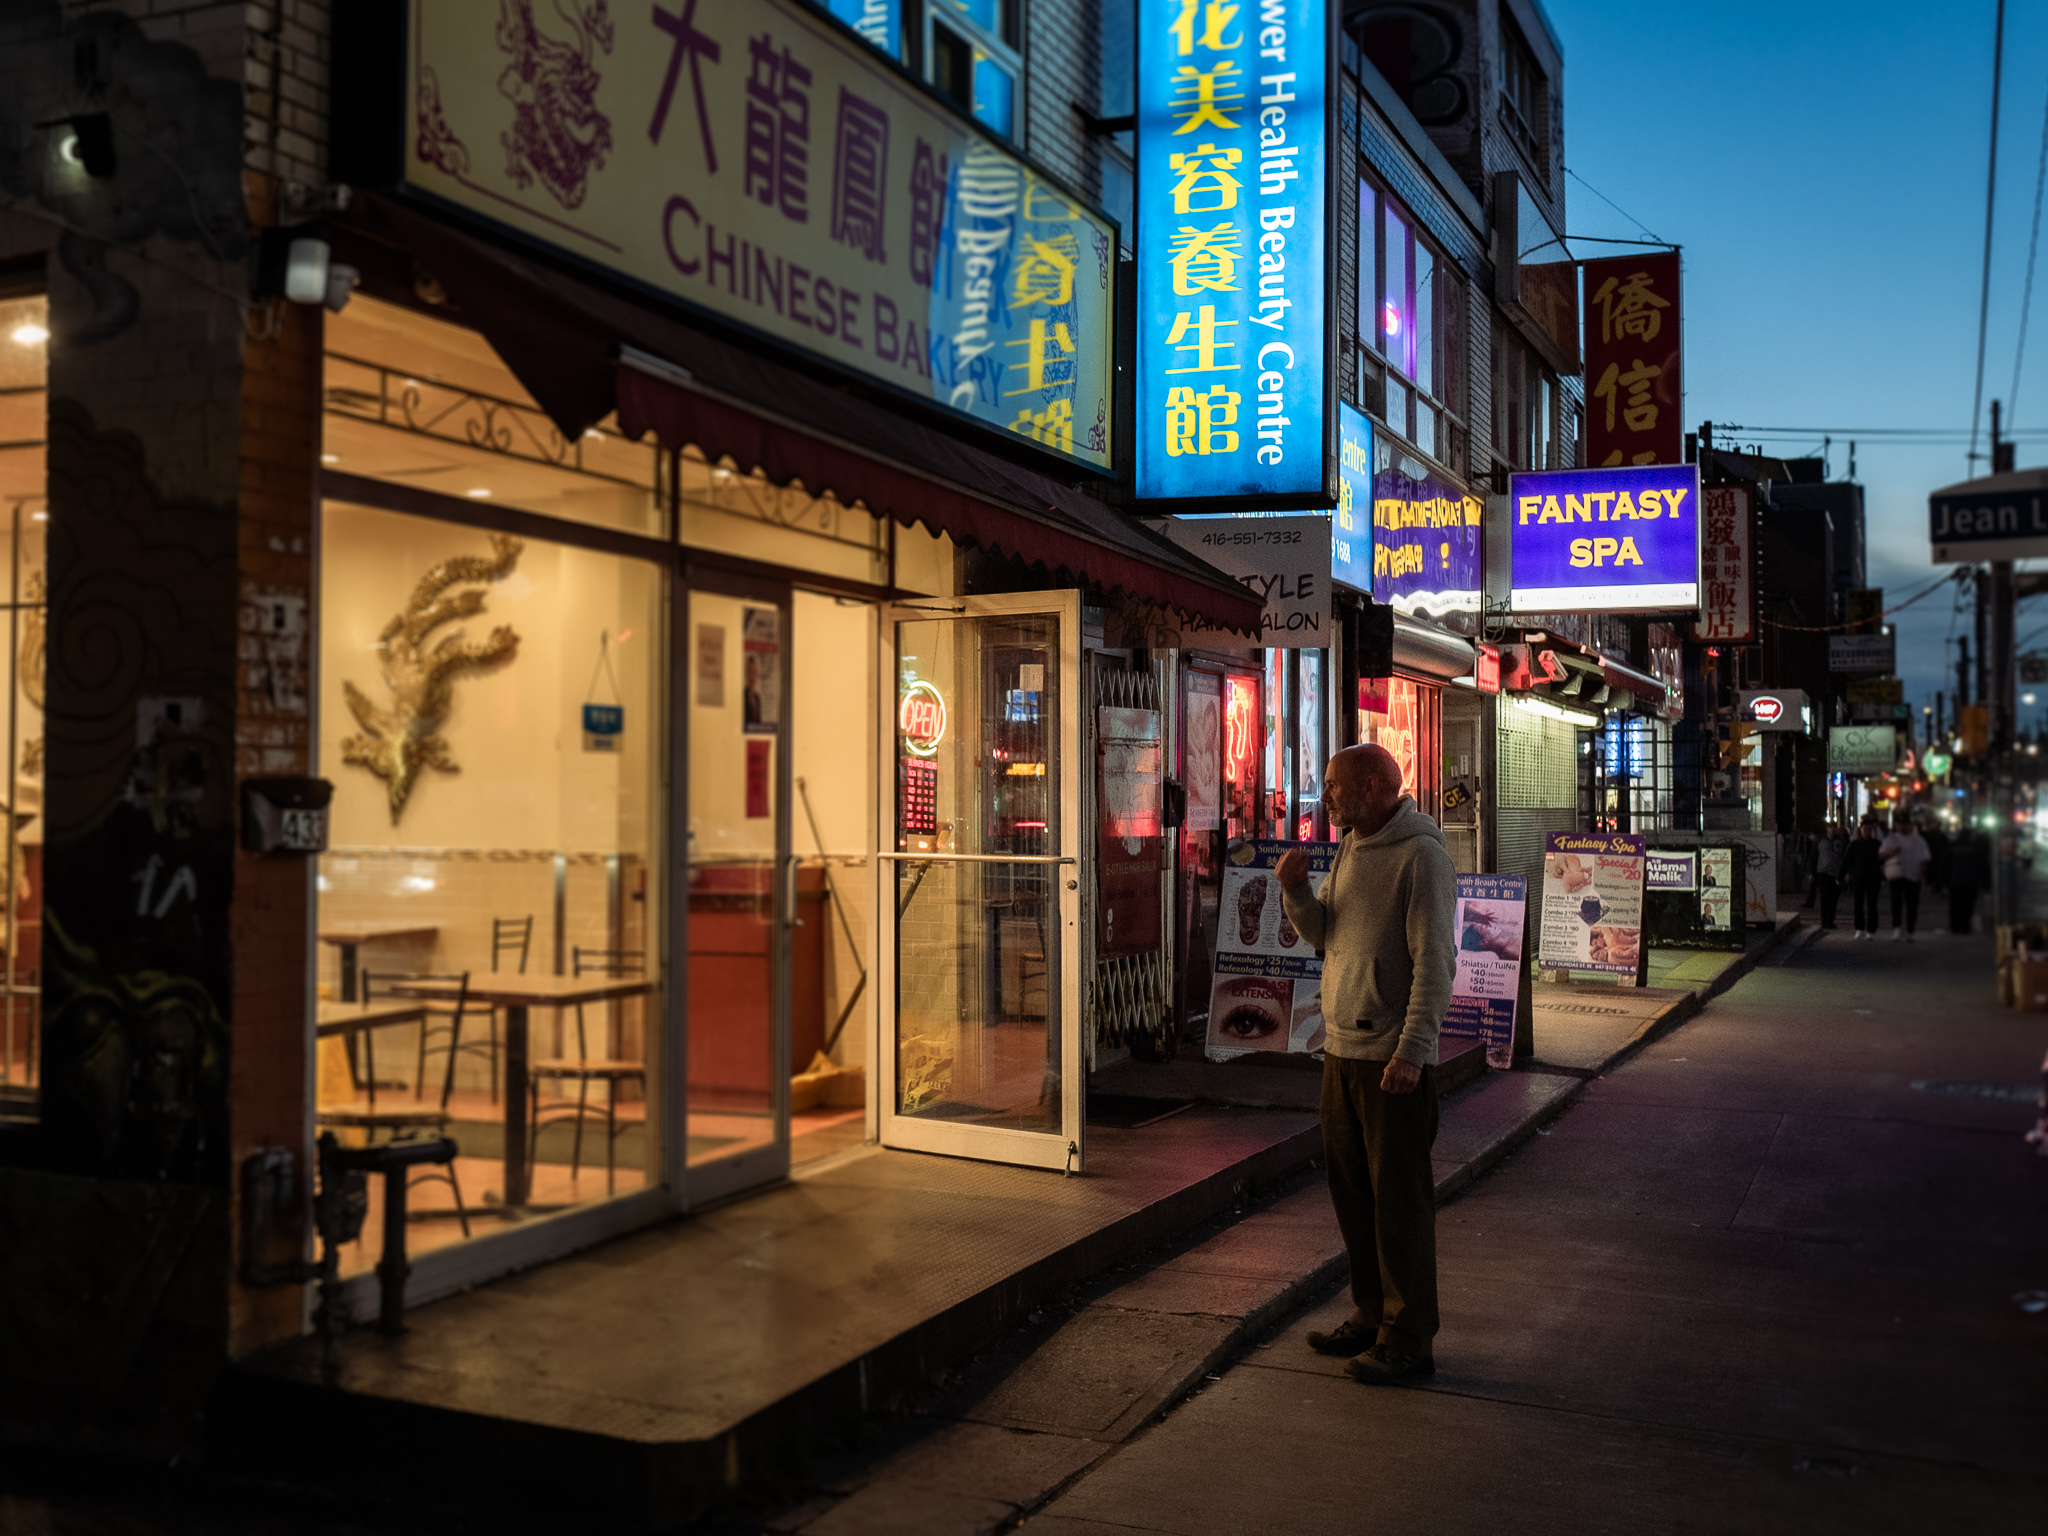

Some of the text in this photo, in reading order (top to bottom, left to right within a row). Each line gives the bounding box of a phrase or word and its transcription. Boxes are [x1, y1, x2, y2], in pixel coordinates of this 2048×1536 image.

[1258, 72, 1298, 196] Health
[1165, 0, 1246, 457] 花美容養生館
[1249, 206, 1296, 333] Beauty
[662, 194, 865, 350] CHINESE
[873, 294, 1005, 409] BAKERY
[1256, 341, 1295, 465] Centre
[1339, 424, 1366, 476] entre
[1518, 487, 1689, 526] FANTASY
[1935, 503, 2019, 536] Jean
[1202, 531, 1302, 546] 416-551-7332
[1569, 536, 1644, 569] SPA
[1230, 573, 1314, 600] TYLE
[1260, 611, 1319, 632] ALON
[905, 699, 944, 738] OPEN
[1258, 844, 1289, 854] Sunflow
[1554, 836, 1636, 854] Fantasy Spa
[1596, 855, 1639, 870] Special
[1622, 868, 1641, 880] $20
[1646, 860, 1687, 872] Ausma
[1457, 877, 1523, 888] ealth Beauty Centre
[1648, 871, 1682, 882] Malik
[1460, 960, 1489, 969] Shiatsu
[1494, 962, 1516, 971] TuiNa
[1451, 997, 1489, 1007] ACKAGE
